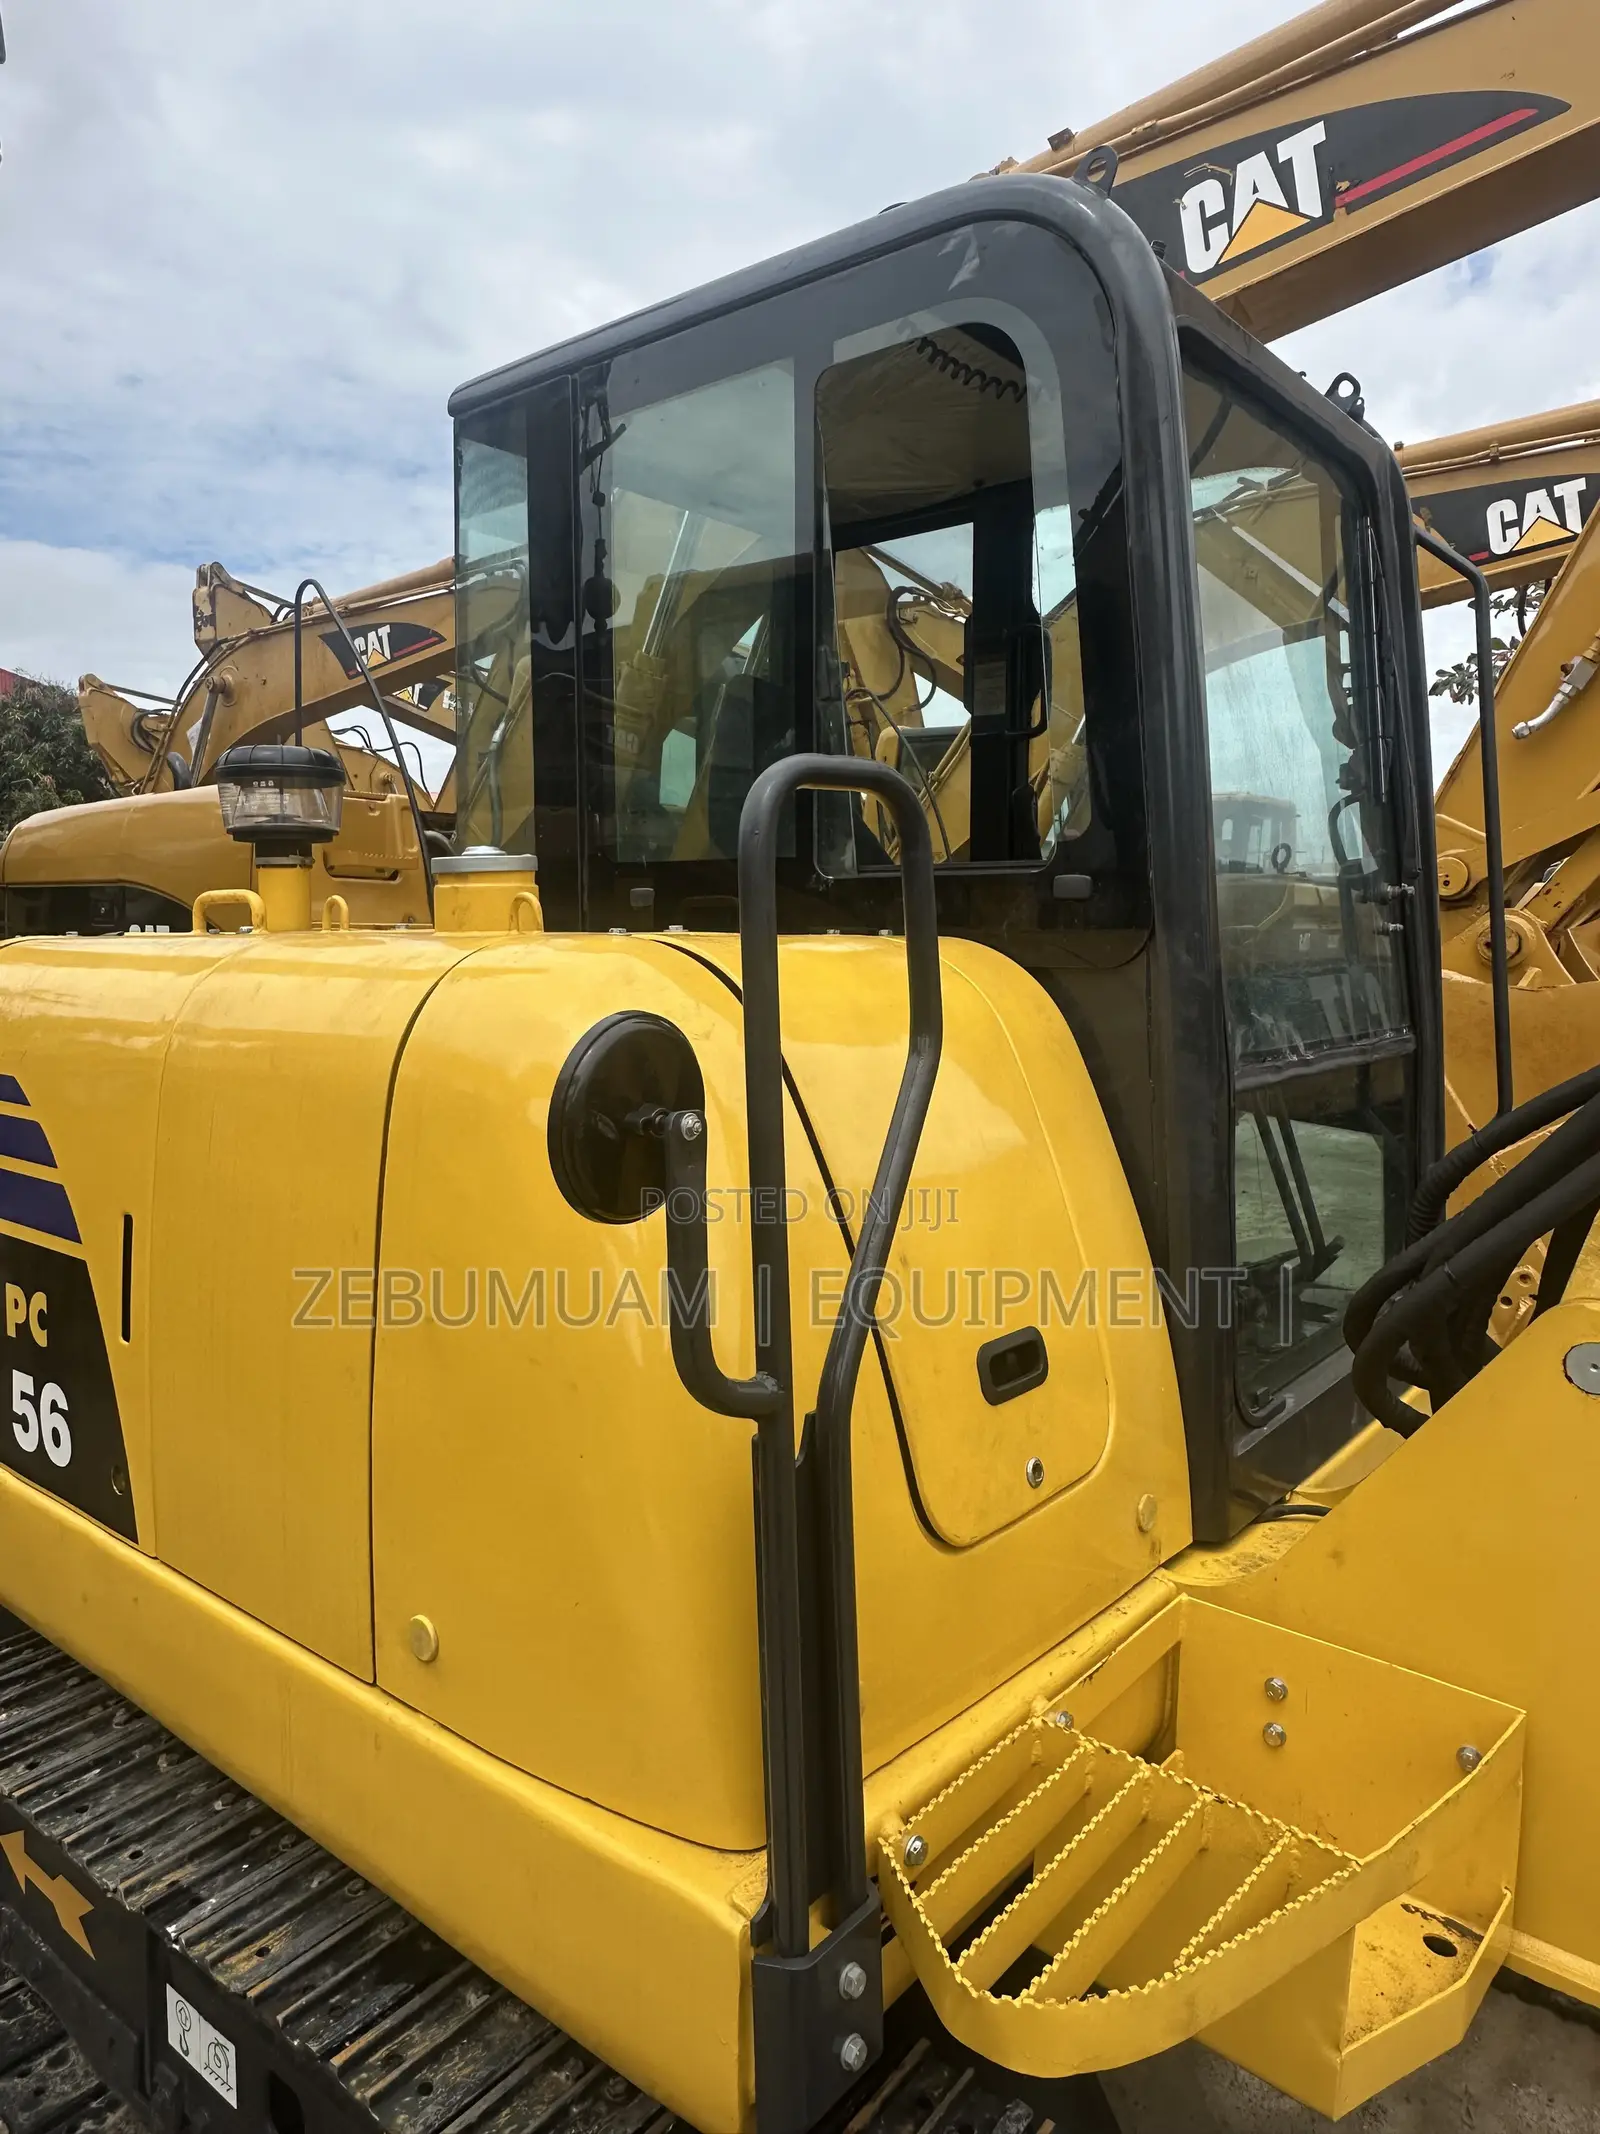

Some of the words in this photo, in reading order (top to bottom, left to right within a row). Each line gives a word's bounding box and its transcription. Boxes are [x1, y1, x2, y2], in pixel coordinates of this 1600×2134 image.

[1180, 120, 1327, 274] CAT
[1486, 477, 1587, 555] CAT
[353, 624, 391, 673] CAT
[5, 1282, 48, 1348] PC
[12, 1368, 72, 1468] 56
